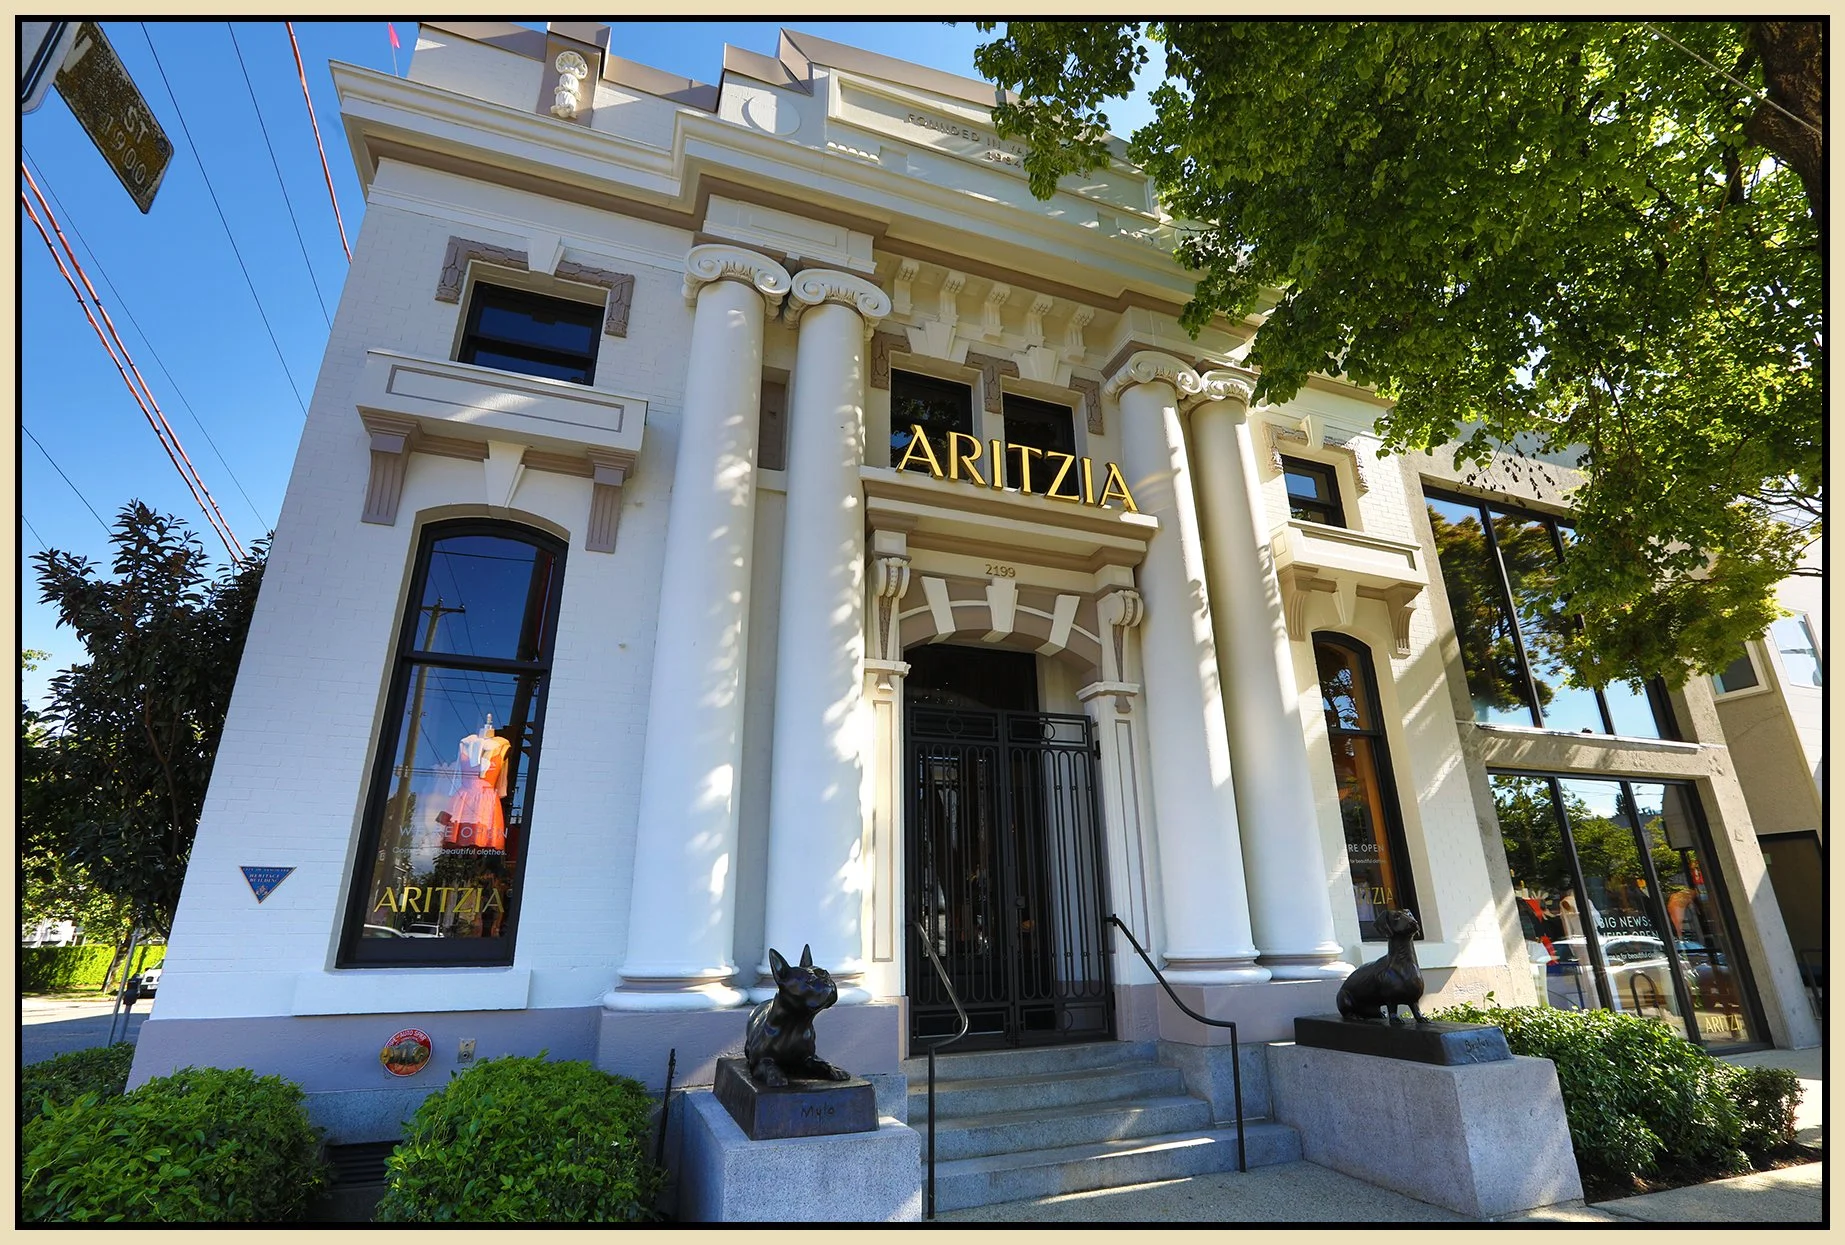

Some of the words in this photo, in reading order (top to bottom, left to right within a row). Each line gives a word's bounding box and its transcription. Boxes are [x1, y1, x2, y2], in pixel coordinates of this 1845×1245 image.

[122, 105, 150, 143] ST
[904, 113, 980, 142] FOUNDED
[100, 115, 148, 185] 1900
[896, 424, 1138, 513] ARITZIA
[985, 563, 1016, 578] 2199
[461, 826, 509, 839] OPEN
[441, 847, 475, 855] beautiful
[476, 848, 507, 857] clothes.
[1361, 844, 1385, 852] OPEN
[374, 887, 505, 913] ARITZIA
[1600, 917, 1617, 928] BIG
[1619, 916, 1652, 927] NEWS:
[801, 1101, 835, 1122] Mylo
